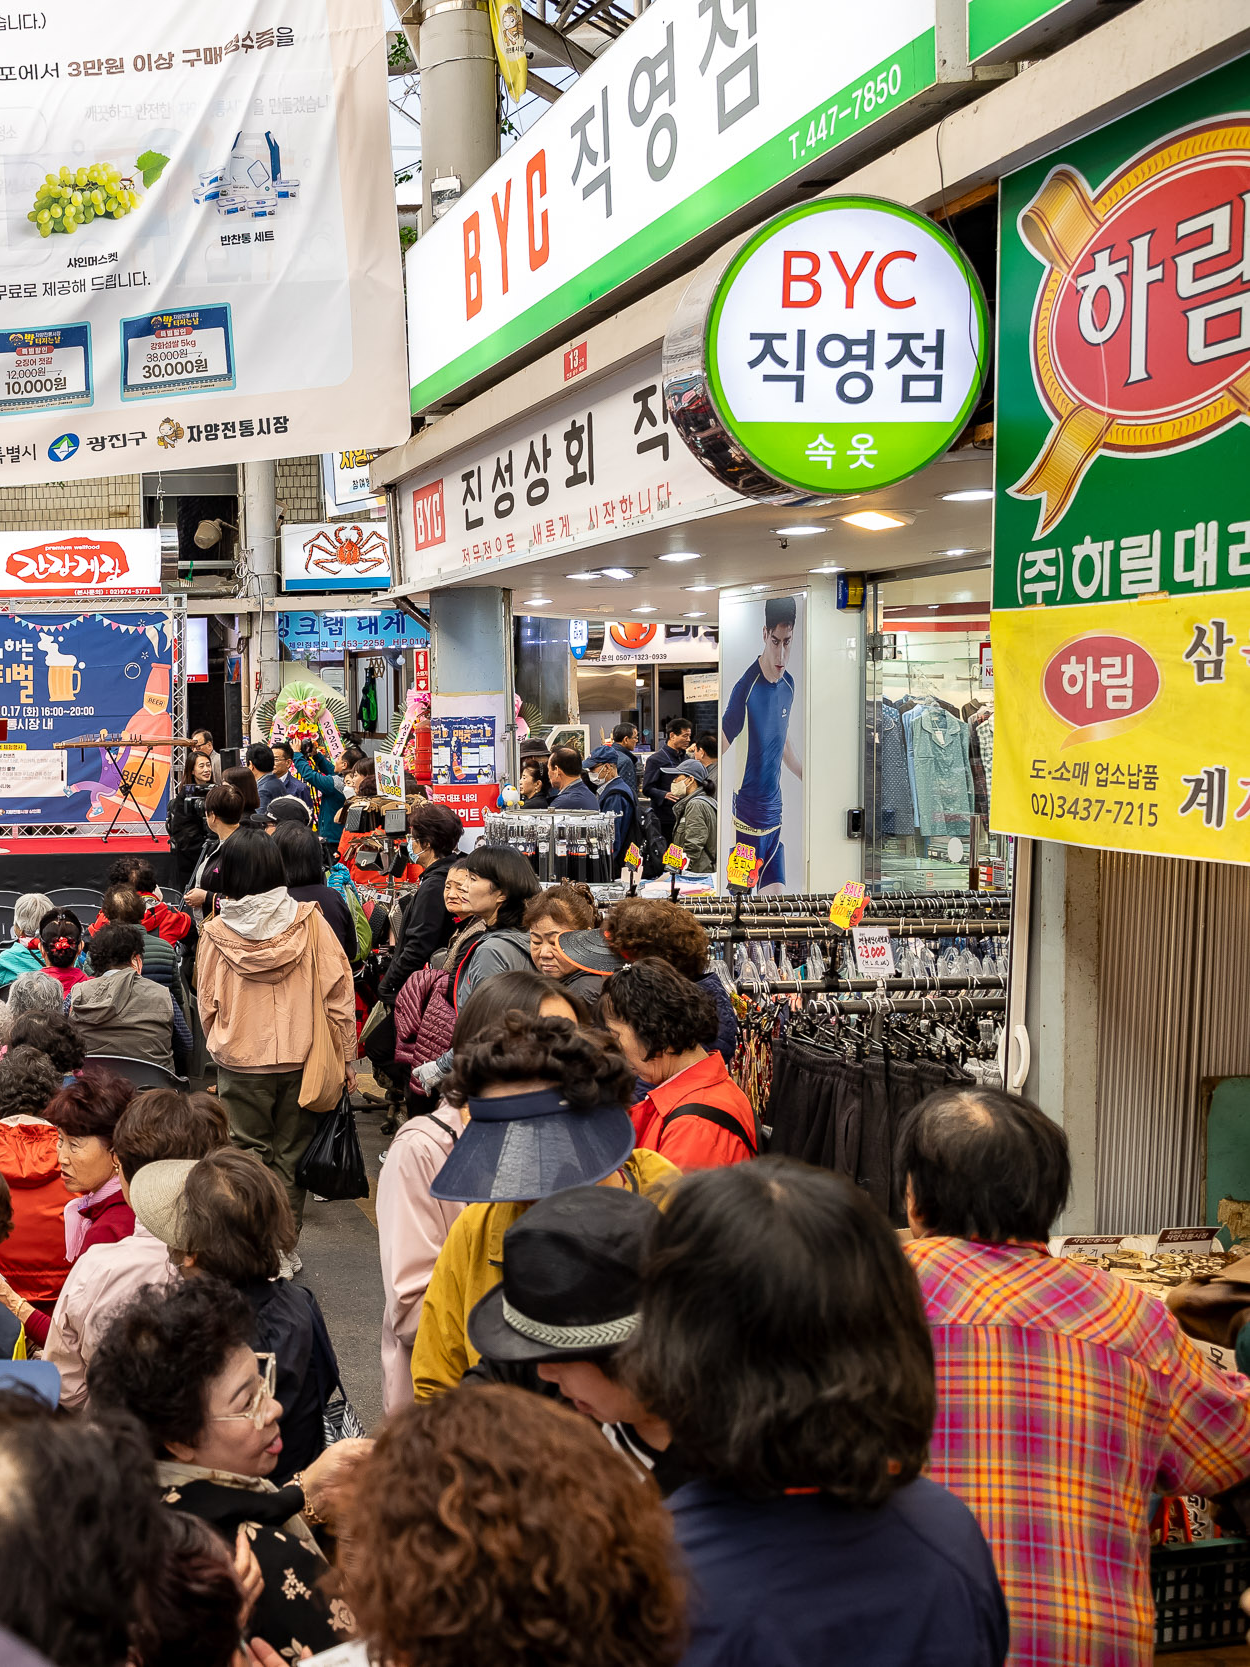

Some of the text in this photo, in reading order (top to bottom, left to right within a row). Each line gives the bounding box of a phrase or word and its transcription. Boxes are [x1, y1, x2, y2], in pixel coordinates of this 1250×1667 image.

[67, 57, 125, 77] 3만원
[133, 51, 174, 72] 이상
[787, 64, 901, 160] T.447-7850
[220, 230, 275, 247] 반찬통 세트
[463, 148, 550, 322] BYC
[43, 278, 87, 297] 제공해
[90, 271, 151, 292] 드립니다.
[781, 250, 918, 310] BYC
[181, 339, 196, 348] 5kg
[15, 358, 37, 367] 오징어
[146, 349, 187, 362] 38,000원
[569, 349, 579, 370] 13
[7, 367, 46, 380] 12,000원
[142, 359, 208, 379] 30,000원
[748, 328, 945, 405] 직영점
[5, 377, 67, 395] 10,000원
[86, 431, 148, 451] 광진구
[187, 416, 289, 444] 자양전통시장
[804, 433, 878, 470] 속옷
[461, 411, 595, 531] 진성상회
[414, 493, 443, 545] BYC
[13, 553, 121, 584] 간장게장
[357, 613, 406, 635] 대게
[4, 639, 34, 661] 하는
[333, 639, 385, 648] T.453-2258
[616, 653, 667, 661] 0507-1323-0939
[1060, 653, 1134, 710] 하림
[22, 706, 39, 718] (화)
[41, 706, 95, 717] 16:00~20:00
[148, 697, 164, 706] BEER
[42, 718, 53, 730] 내
[122, 769, 155, 788] BEER
[1094, 762, 1159, 791] 업소납품
[461, 793, 478, 802] 내의
[1031, 793, 1159, 827] 02)3437-7215
[736, 845, 754, 860] SALE
[844, 883, 863, 898] SALE
